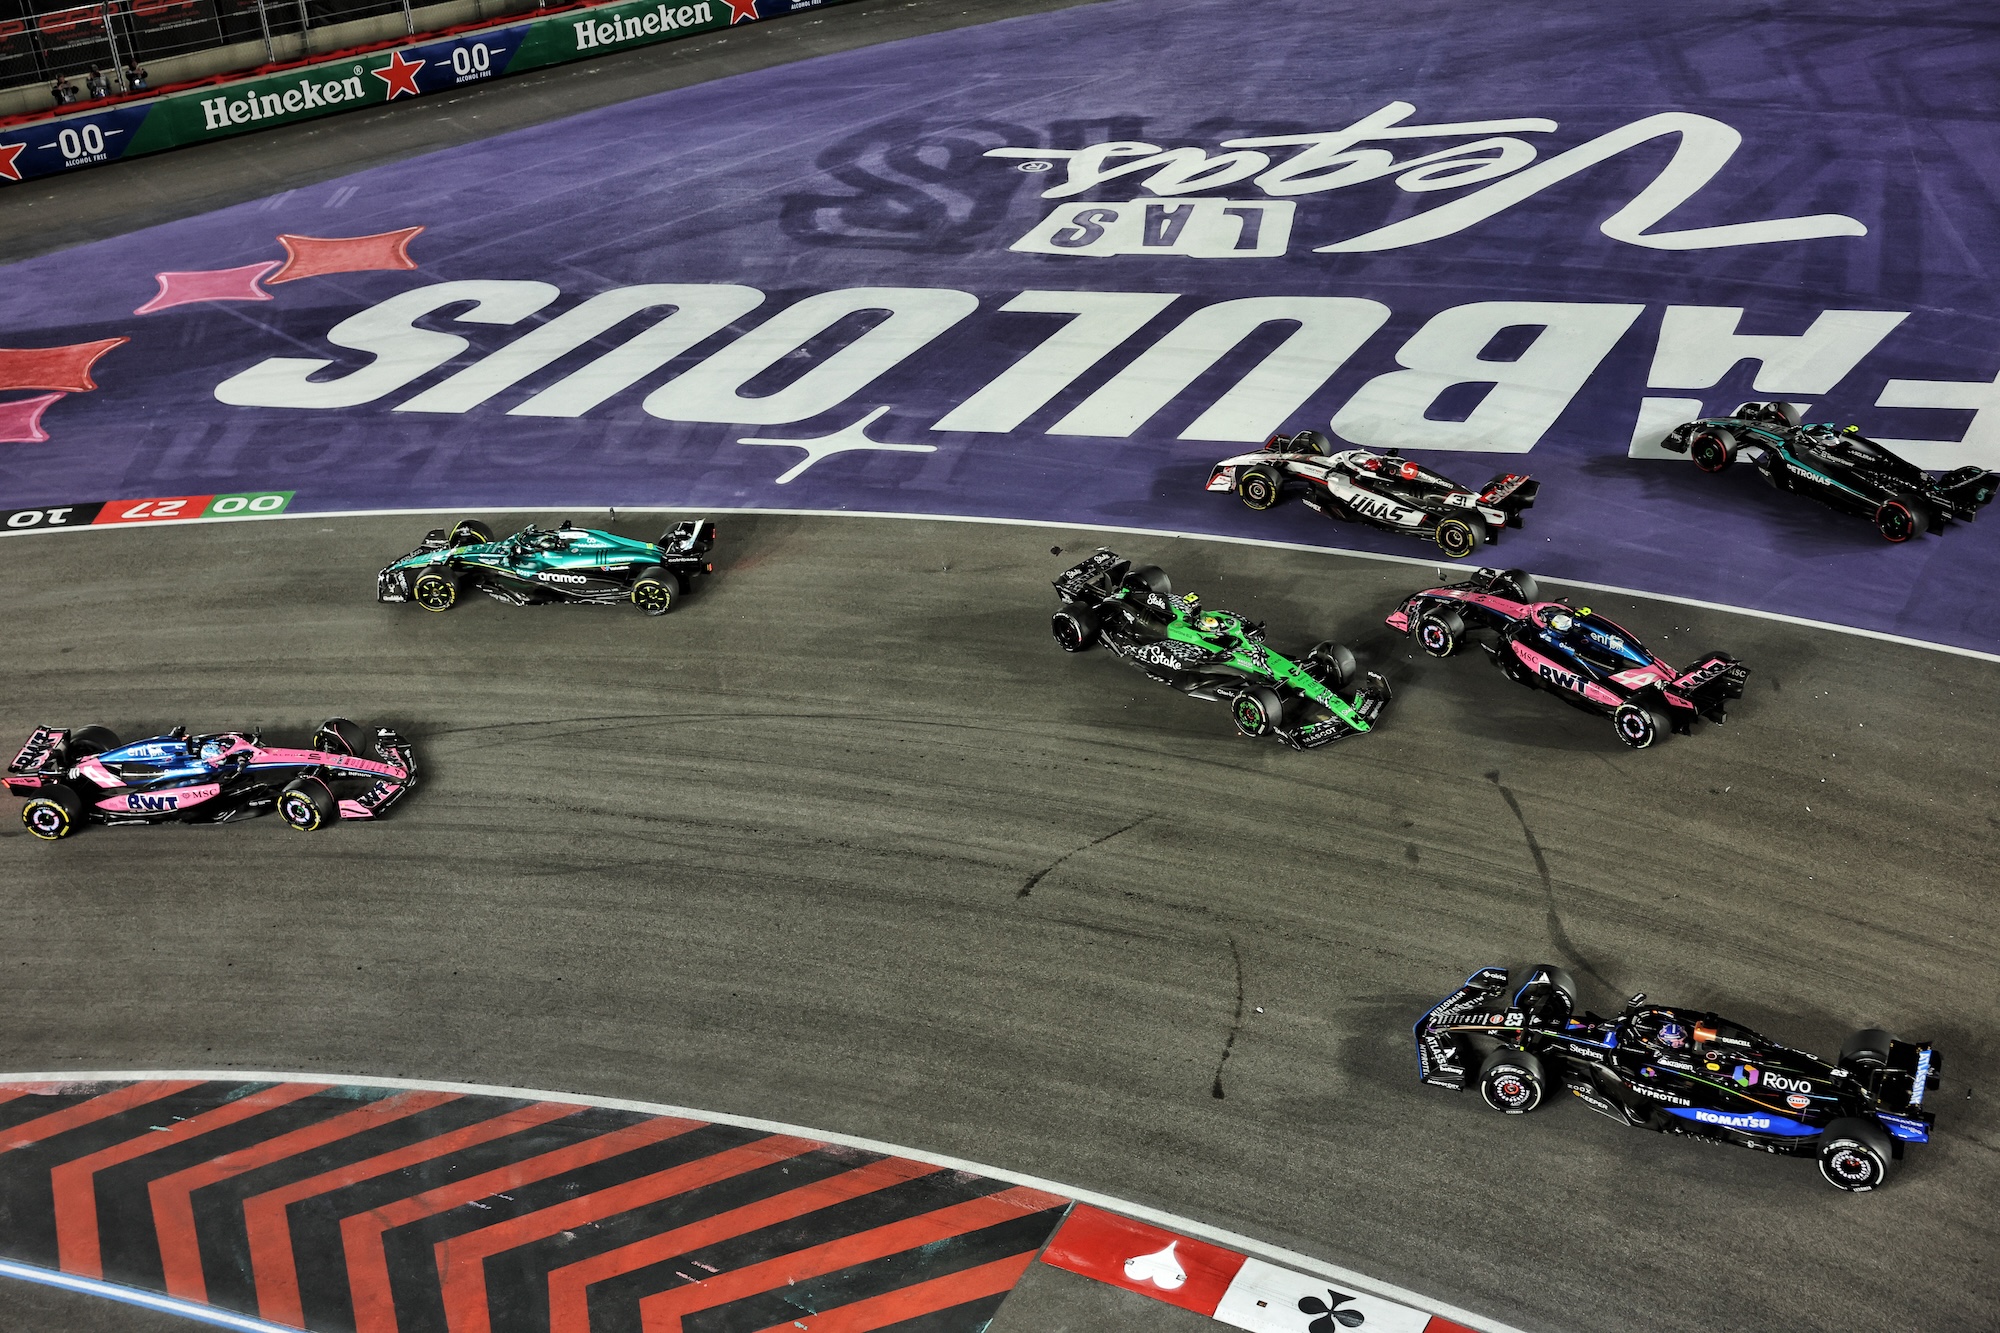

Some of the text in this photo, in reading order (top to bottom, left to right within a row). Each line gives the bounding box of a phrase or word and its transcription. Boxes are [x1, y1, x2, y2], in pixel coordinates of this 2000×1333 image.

[573, 0, 713, 51] Heineken
[452, 43, 491, 76] 0.0
[456, 70, 491, 84] ALCOHOL FREE
[58, 123, 105, 160] 0.0
[65, 152, 107, 168] ALCOHOL FREE
[1049, 202, 1263, 249] LAS
[1786, 463, 1831, 486] PETRONAS
[121, 500, 187, 519] 27
[212, 495, 285, 513] 00
[1452, 495, 1467, 507] 31
[538, 571, 587, 585] aramco
[1146, 592, 1166, 610] Stake
[1590, 632, 1608, 646] eni
[1150, 645, 1182, 670] Stake
[1518, 649, 1539, 664] MSC
[1539, 663, 1588, 693] BWT
[1302, 726, 1337, 743] MASCOT
[127, 793, 179, 811] BWT
[193, 789, 217, 799] MSC
[1429, 990, 1466, 1017] MYPROTEIN
[1763, 1071, 1812, 1094] Rovo
[1579, 1093, 1609, 1111] KEEPER
[1632, 1084, 1690, 1107] MYPROTEIN
[1695, 1110, 1771, 1129] KOMATSU
